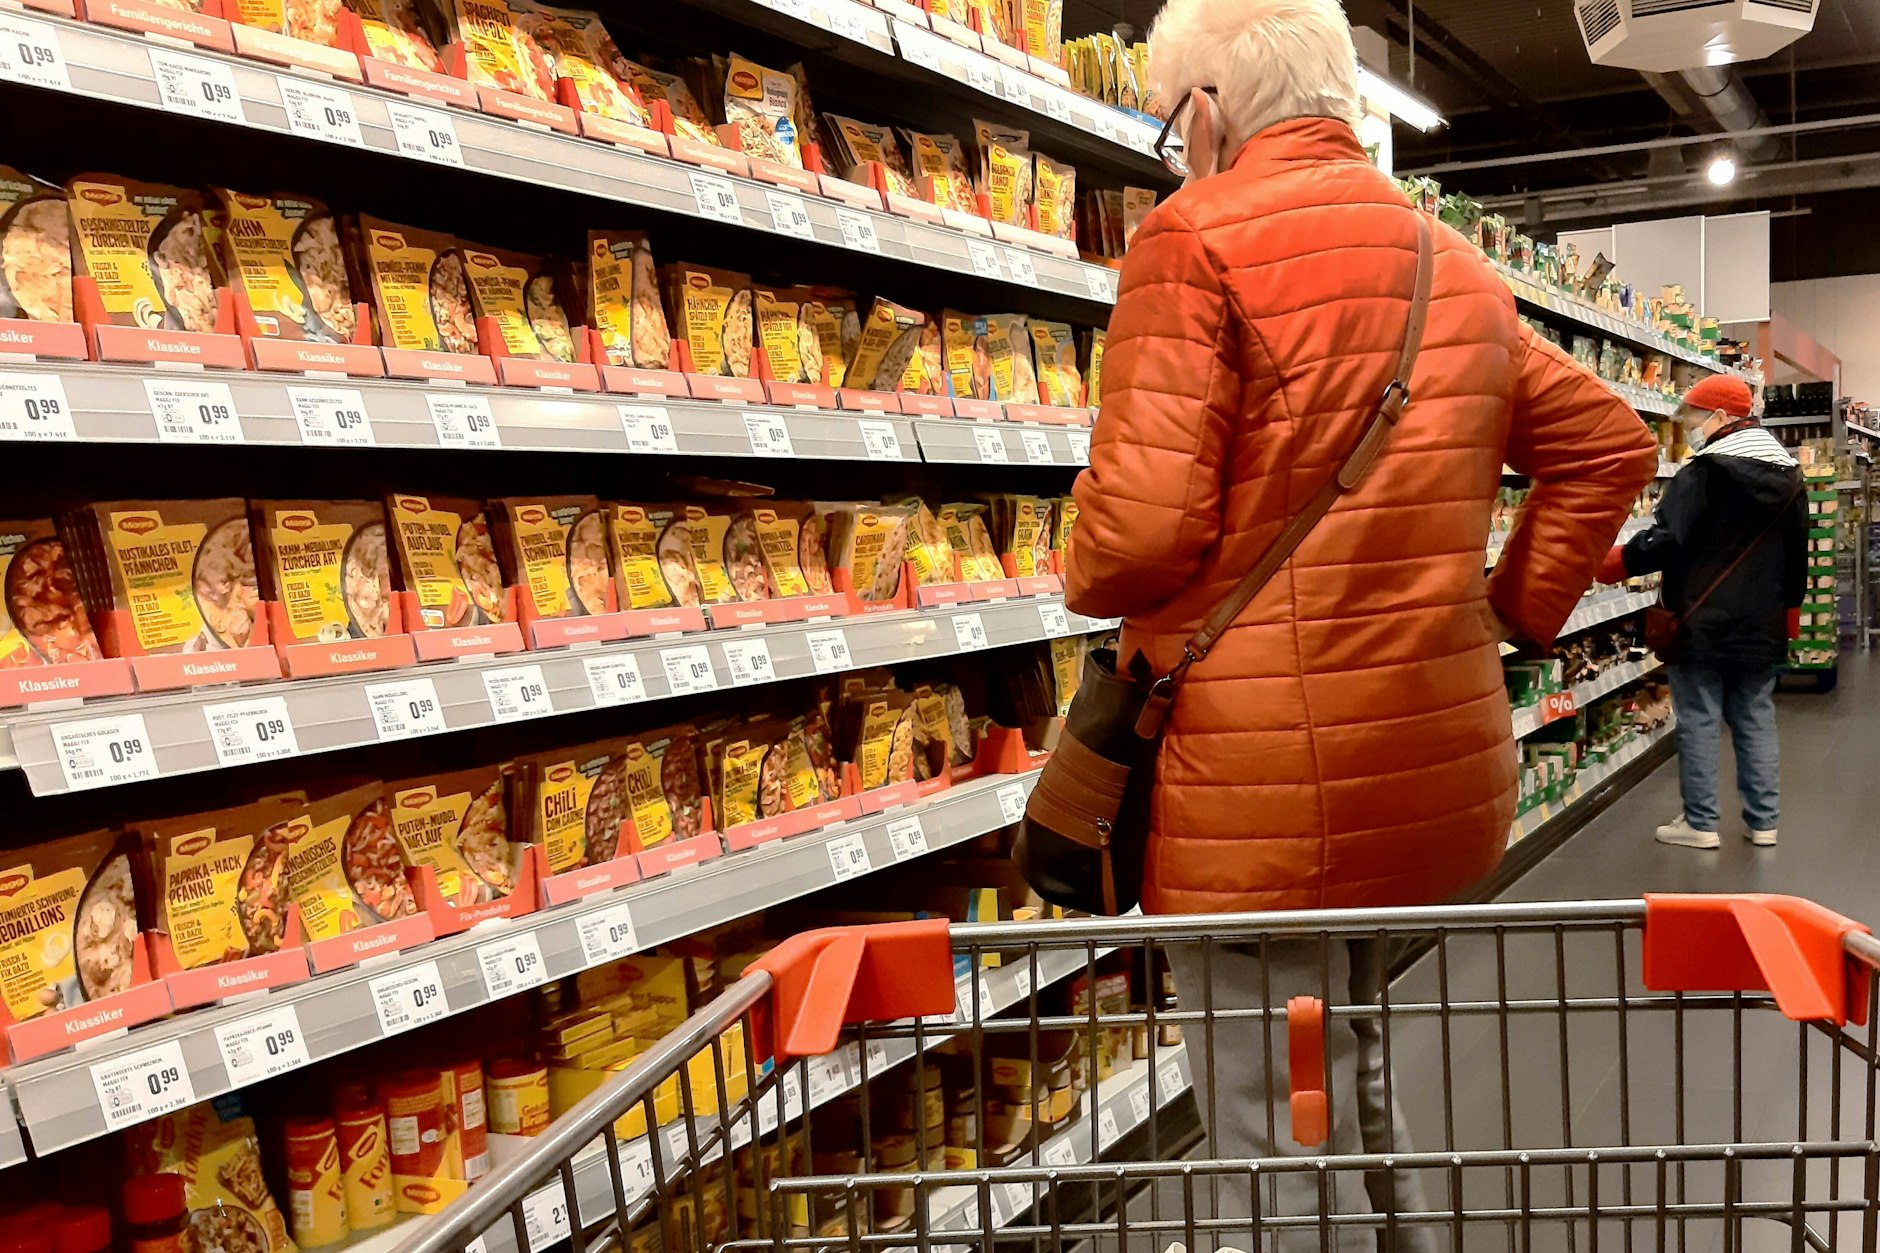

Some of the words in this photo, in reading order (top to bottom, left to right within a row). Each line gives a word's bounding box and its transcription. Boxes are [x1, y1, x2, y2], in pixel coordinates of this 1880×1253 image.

[110, 4, 212, 37] Familiengerichte
[464, 1, 511, 27] SPAGHETTI
[467, 15, 507, 40] NAPOLI
[18, 43, 55, 67] 0.99
[201, 82, 231, 103] 0.99
[383, 69, 461, 97] Familiengerichte
[324, 107, 351, 127] 0.99
[429, 130, 452, 149] 0.99
[229, 218, 266, 237] RAHM
[148, 339, 202, 354] Klassiker
[298, 351, 345, 364] Klassiker
[422, 359, 463, 373] Klassiker
[25, 399, 60, 421] 0.99
[199, 405, 230, 425] 0.99
[335, 410, 362, 429] 0.99
[467, 415, 491, 432] 0.99
[651, 424, 669, 440] 0.99
[119, 543, 170, 562] RUSTIKALES
[170, 540, 198, 556] FILET-
[278, 538, 343, 557] RAHM-MEDAILLONS
[407, 535, 443, 551] AUFLAUF
[523, 543, 565, 562] SCHNITZEL
[124, 555, 178, 576] PFÄNNCHEN
[281, 555, 322, 571] ZÜRCHER
[322, 551, 338, 566] ART
[135, 604, 146, 612] FIX
[563, 624, 599, 636] Klassiker
[451, 635, 492, 648] Klassiker
[330, 650, 377, 663] Klassiker
[751, 655, 767, 671] 0.99
[183, 661, 237, 675] Klassiker
[691, 662, 709, 678] 0.99
[19, 676, 80, 693] Klassiker
[617, 671, 637, 688] 0.99
[520, 684, 542, 703] 0.99
[409, 700, 433, 719] 0.99
[256, 719, 285, 741] 0.99
[109, 739, 142, 763] 0.99
[627, 766, 653, 794] CHILI
[544, 787, 577, 818] CHILI
[398, 809, 458, 836] PUTEN-NUDEL
[546, 816, 562, 832] CON
[170, 855, 242, 887] PAPRIKA-HACK
[576, 873, 612, 890] Klassiker
[36, 888, 79, 910] SCHWEINE-
[169, 879, 215, 905] PFANNE
[460, 903, 511, 923] Fix-Produkte
[0, 906, 65, 944] EDAILLONS
[174, 921, 196, 932] FRISCH
[196, 919, 202, 927] &
[175, 931, 186, 941] FIX
[187, 927, 203, 938] DAZU
[609, 922, 629, 942] 0.99
[352, 932, 398, 953] Klassiker
[0, 954, 21, 970] RISCH
[1, 966, 12, 979] FIX
[12, 961, 30, 975] DAZU
[514, 952, 537, 974] 0.99
[217, 968, 270, 988] Klassiker
[413, 984, 437, 1007] 0.99
[64, 1006, 124, 1035] Klassiker
[265, 1030, 295, 1056] 0.99
[103, 1079, 119, 1088] MAGGI
[147, 1066, 179, 1095] 0.99
[147, 1106, 159, 1115] 100
